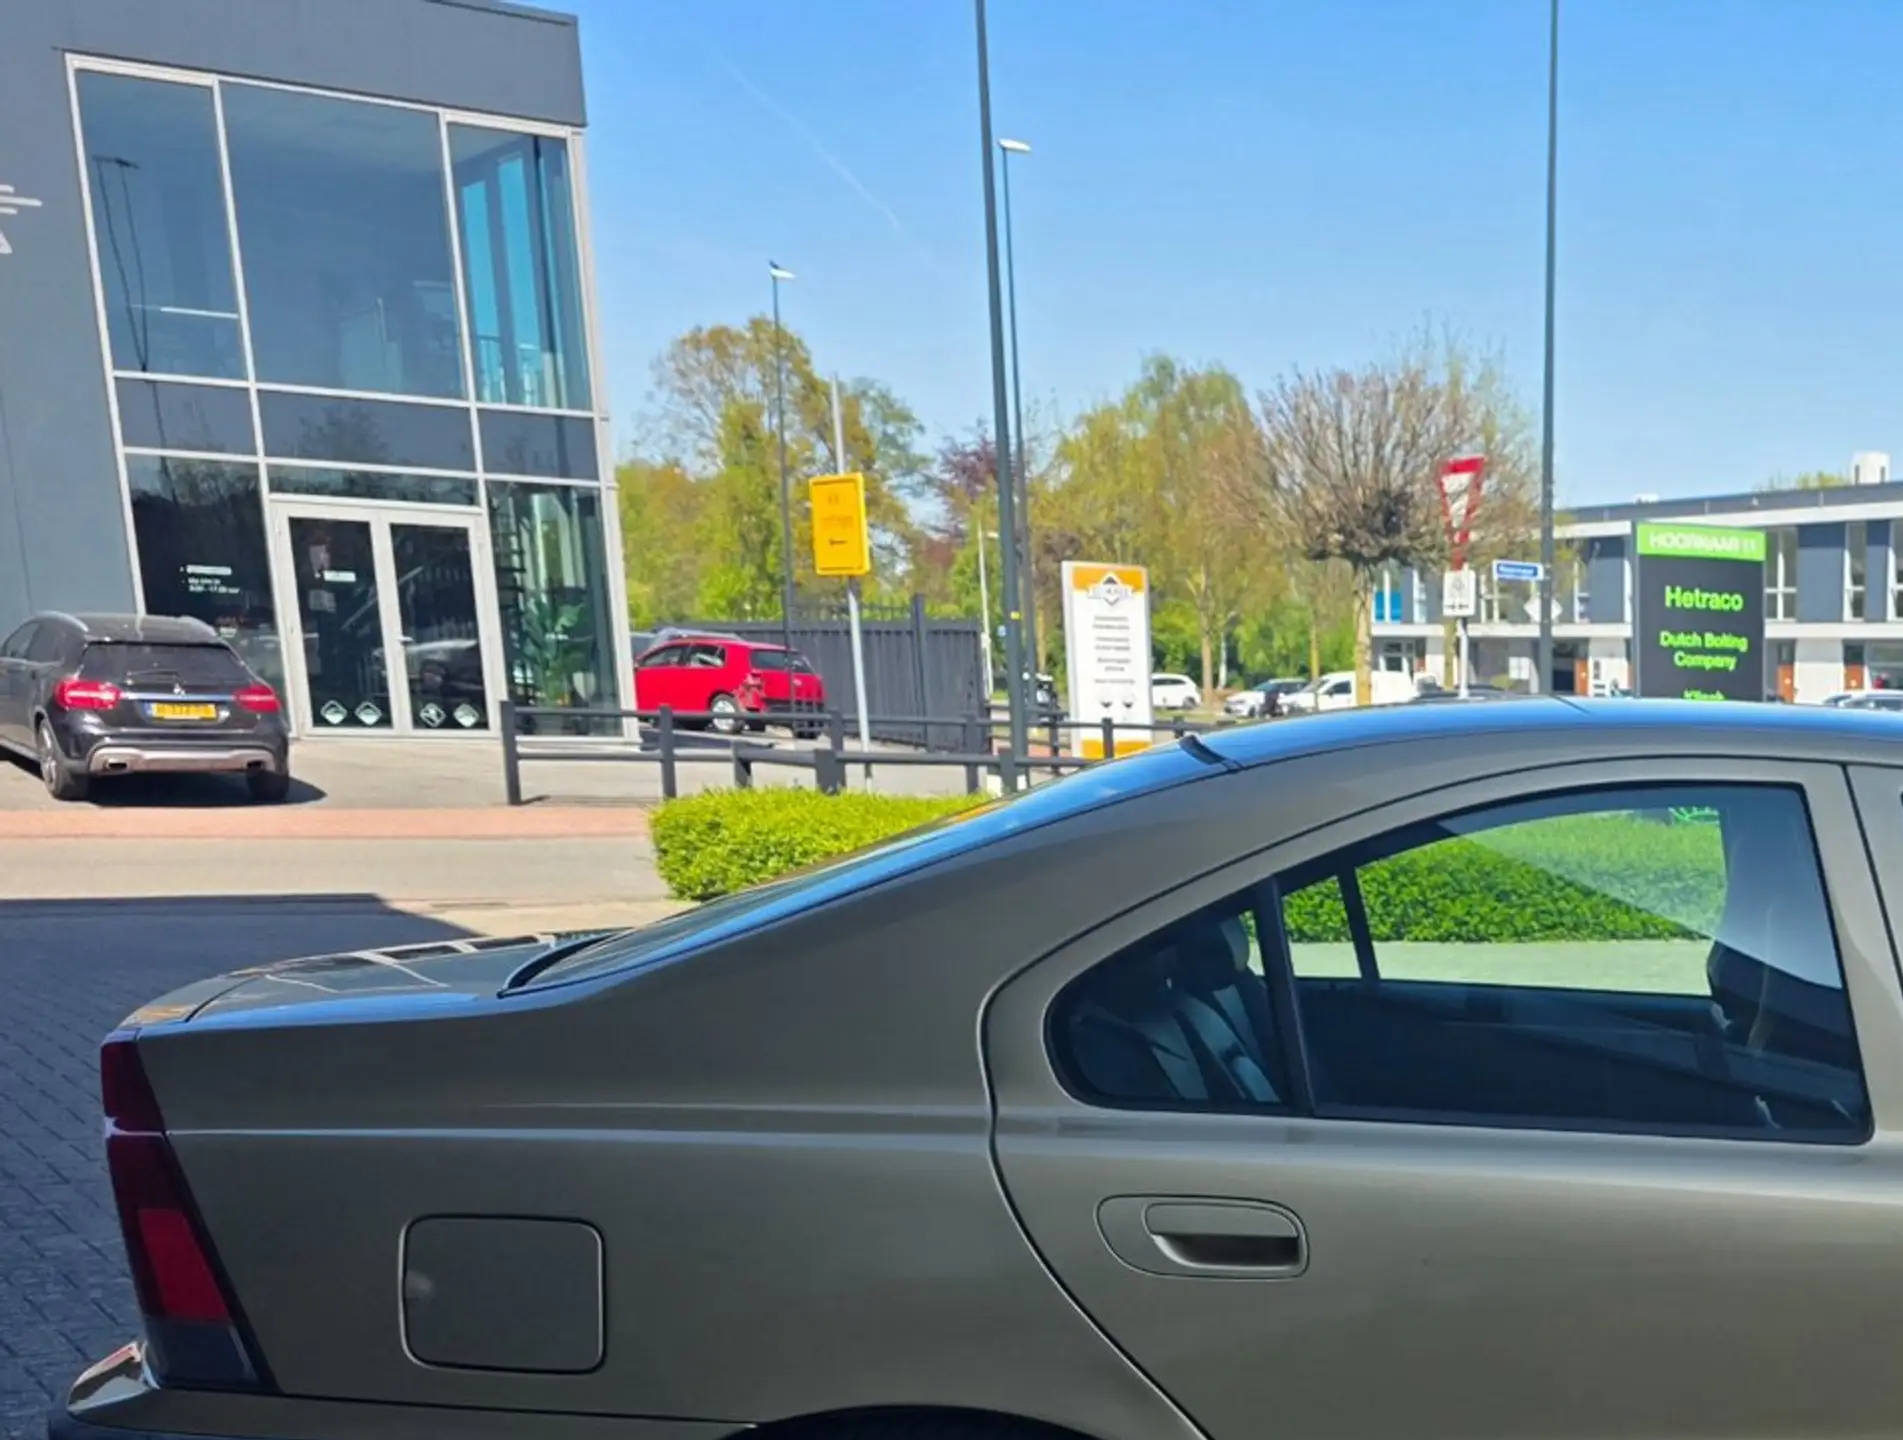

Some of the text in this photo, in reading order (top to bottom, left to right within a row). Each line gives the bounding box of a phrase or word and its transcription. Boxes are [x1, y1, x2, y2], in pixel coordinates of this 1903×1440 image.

[1665, 585, 1744, 612] Hetraco
[1660, 630, 1702, 648] Dutch
[1674, 650, 1737, 672] Company
